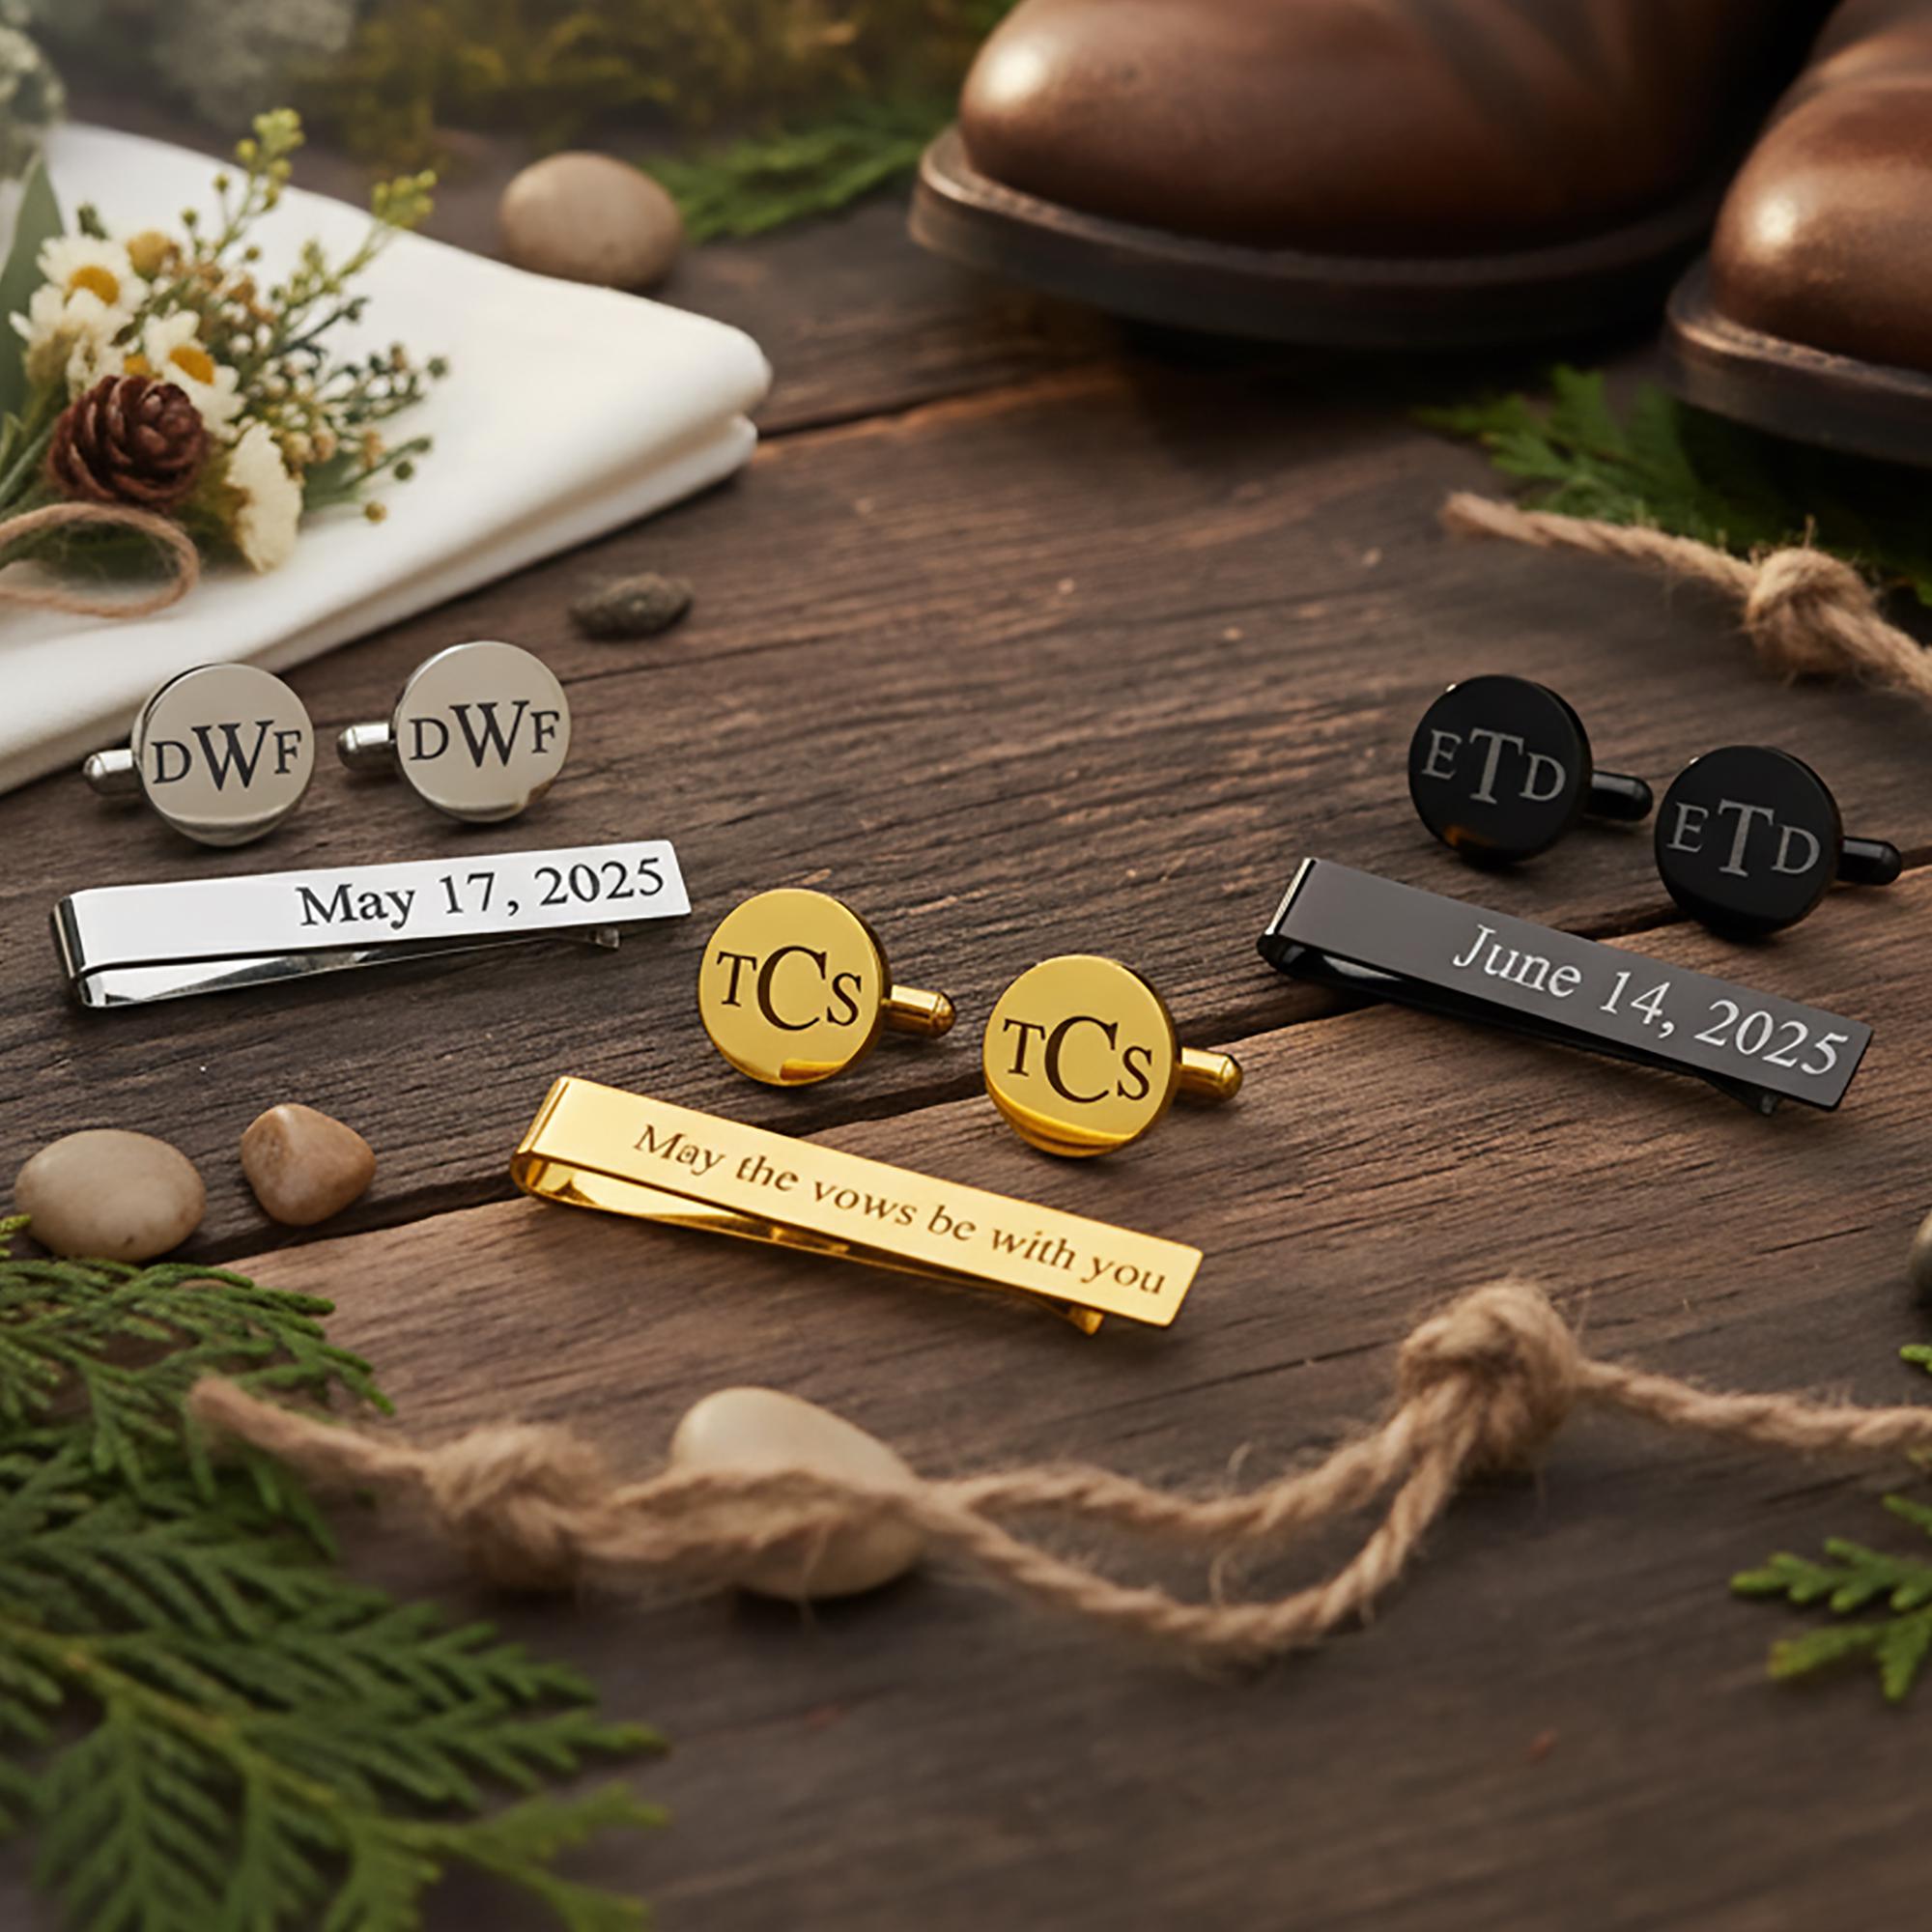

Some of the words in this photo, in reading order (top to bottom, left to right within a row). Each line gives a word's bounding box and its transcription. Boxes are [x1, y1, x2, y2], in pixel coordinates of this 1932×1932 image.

[151, 720, 302, 792] DWF
[409, 699, 560, 768] DWF
[1421, 727, 1567, 805] ETD
[1666, 798, 1822, 878] ETD
[296, 883, 415, 929] May
[439, 872, 520, 916] 17,
[533, 857, 666, 907] 2025
[716, 945, 863, 1032] TCS
[1453, 923, 1583, 999] June
[1600, 970, 1676, 1039] 14,
[1693, 999, 1850, 1077] 2025
[1003, 1015, 1153, 1103] TCS
[633, 1124, 726, 1178] May
[735, 1155, 799, 1192] the
[811, 1181, 917, 1228] vows
[927, 1204, 976, 1241] be
[992, 1228, 1075, 1272] with
[1079, 1256, 1167, 1296] you
